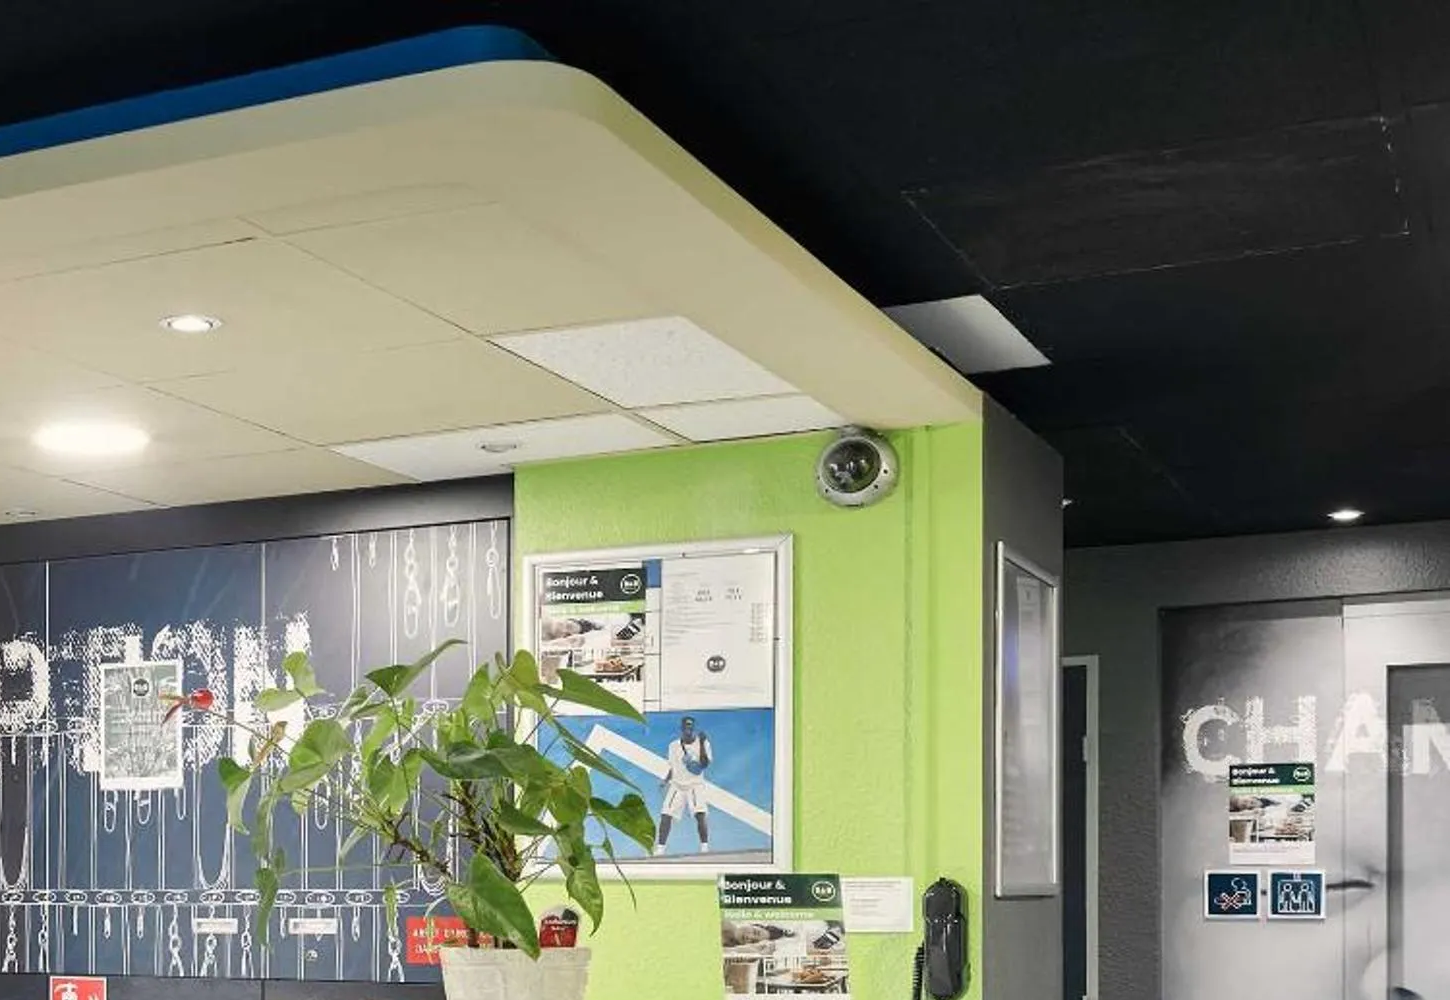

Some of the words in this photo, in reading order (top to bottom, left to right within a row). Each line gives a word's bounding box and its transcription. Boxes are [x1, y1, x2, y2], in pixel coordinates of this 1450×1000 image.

[590, 576, 599, 585] &
[723, 880, 774, 892] Bonjour
[775, 880, 786, 890] &
[723, 895, 792, 905] Bienvenue
